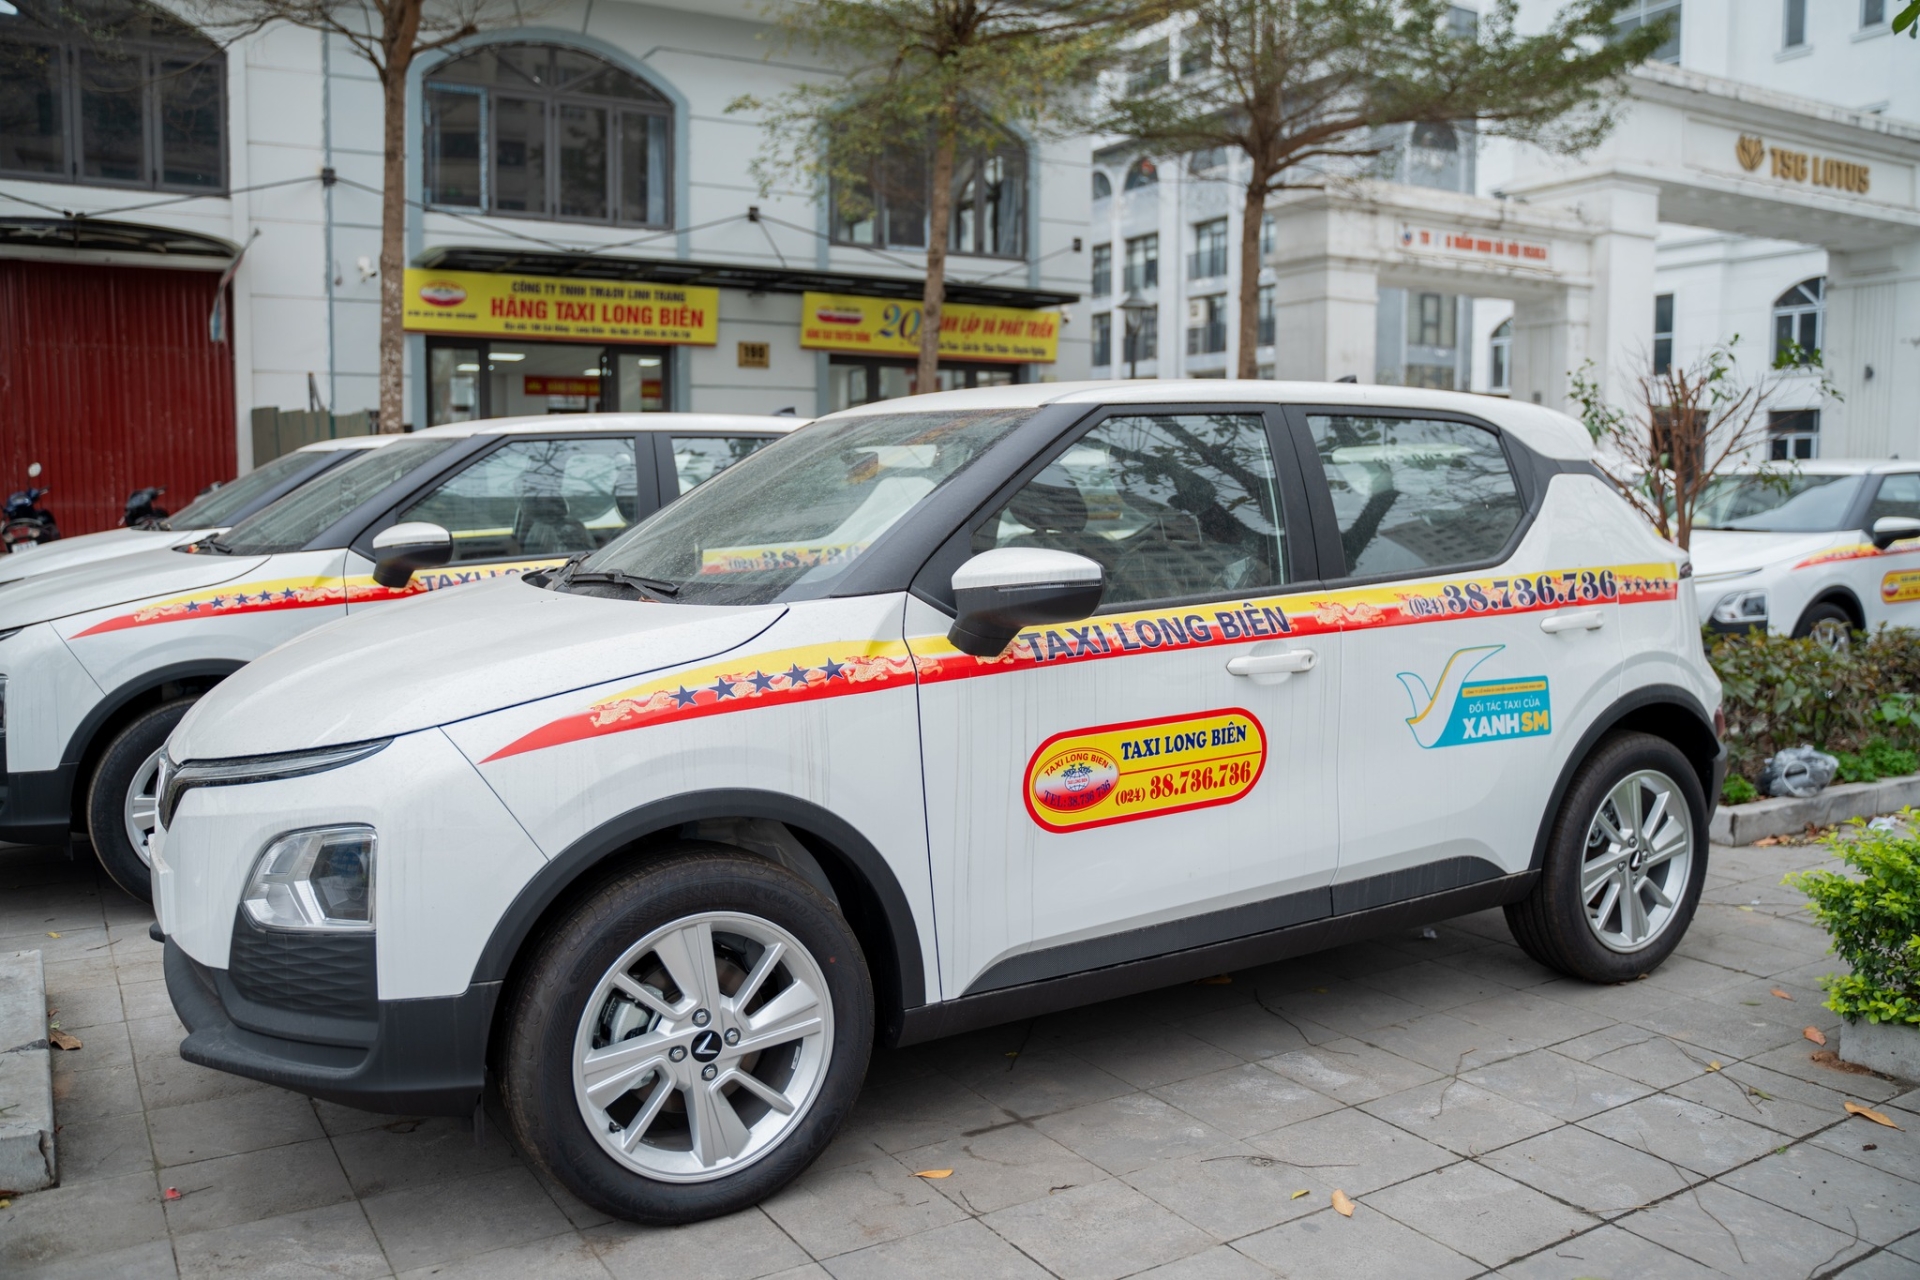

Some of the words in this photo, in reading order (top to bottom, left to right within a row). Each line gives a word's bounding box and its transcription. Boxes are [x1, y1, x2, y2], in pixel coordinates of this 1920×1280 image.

[1770, 146, 1808, 182] TSG
[1812, 155, 1870, 194] LOTUS
[491, 293, 548, 320] HÃNG
[555, 301, 595, 321] TAXI
[602, 304, 653, 325] LONG
[660, 303, 704, 328] BIÊN
[874, 303, 922, 338] 20
[1408, 597, 1445, 618] (024)
[1443, 570, 1617, 613] 38.736.736
[1018, 625, 1111, 662] TAXI
[1113, 615, 1212, 650] LONG
[1215, 602, 1291, 639] BIÊN
[1469, 700, 1484, 714] ĐỐI
[1503, 700, 1521, 709] TAXI
[1523, 695, 1540, 708] CỦA
[1121, 737, 1160, 760] TAXI
[1165, 731, 1207, 753] LONG
[1211, 721, 1247, 747] BIÊN
[1462, 712, 1519, 739] XANH
[1521, 710, 1549, 732] SM
[1044, 759, 1064, 777] TAXI
[1066, 753, 1088, 764] LONG
[1044, 790, 1066, 807] TEL:
[1115, 787, 1145, 806] (024)
[1150, 760, 1251, 799] 38.736.736
